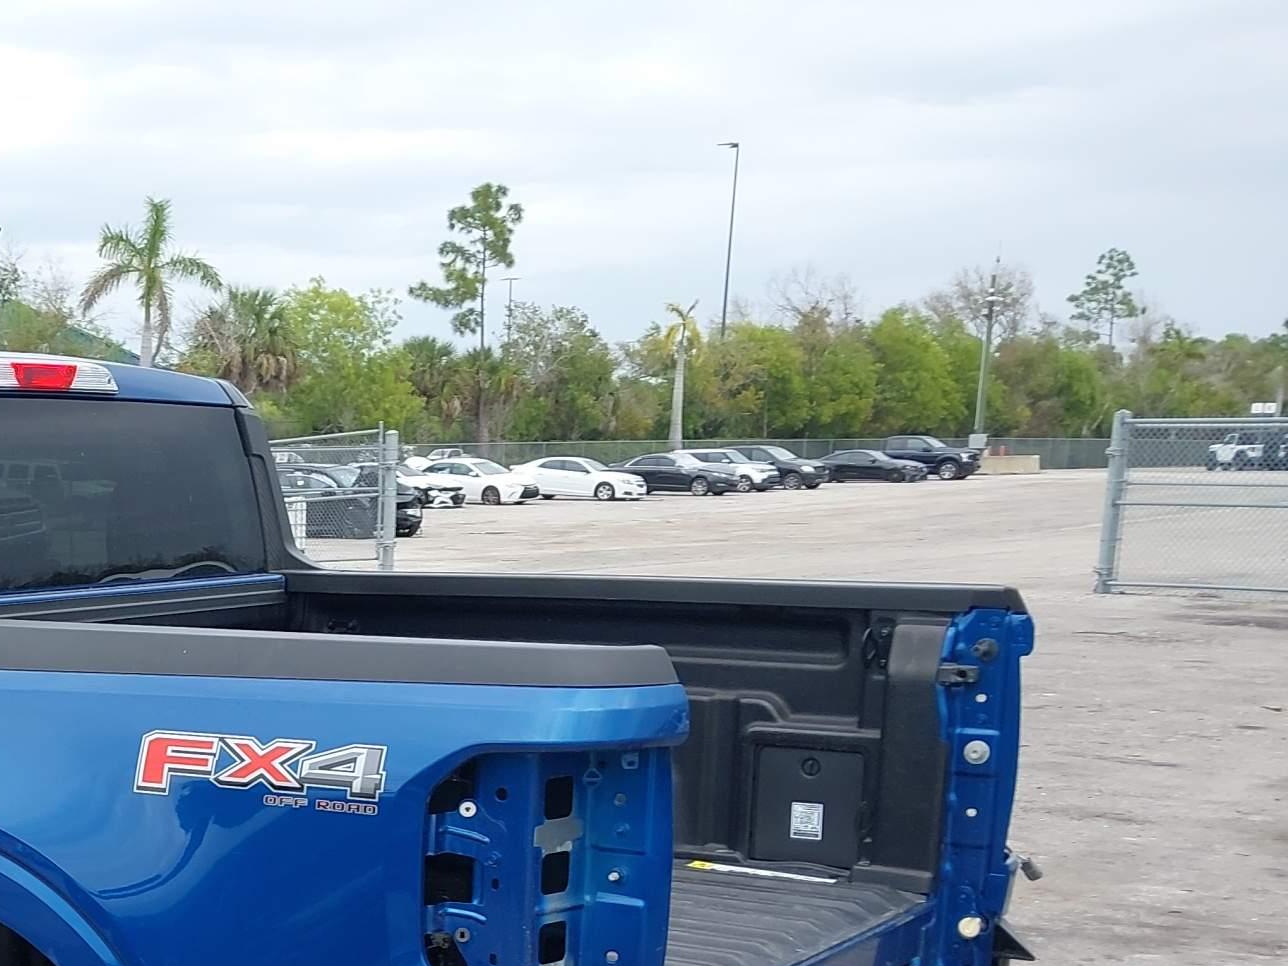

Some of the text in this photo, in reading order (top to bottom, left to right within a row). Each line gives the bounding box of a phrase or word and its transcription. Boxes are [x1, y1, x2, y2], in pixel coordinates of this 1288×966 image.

[133, 729, 388, 801] FX4
[263, 794, 379, 816] OFF ROAD
